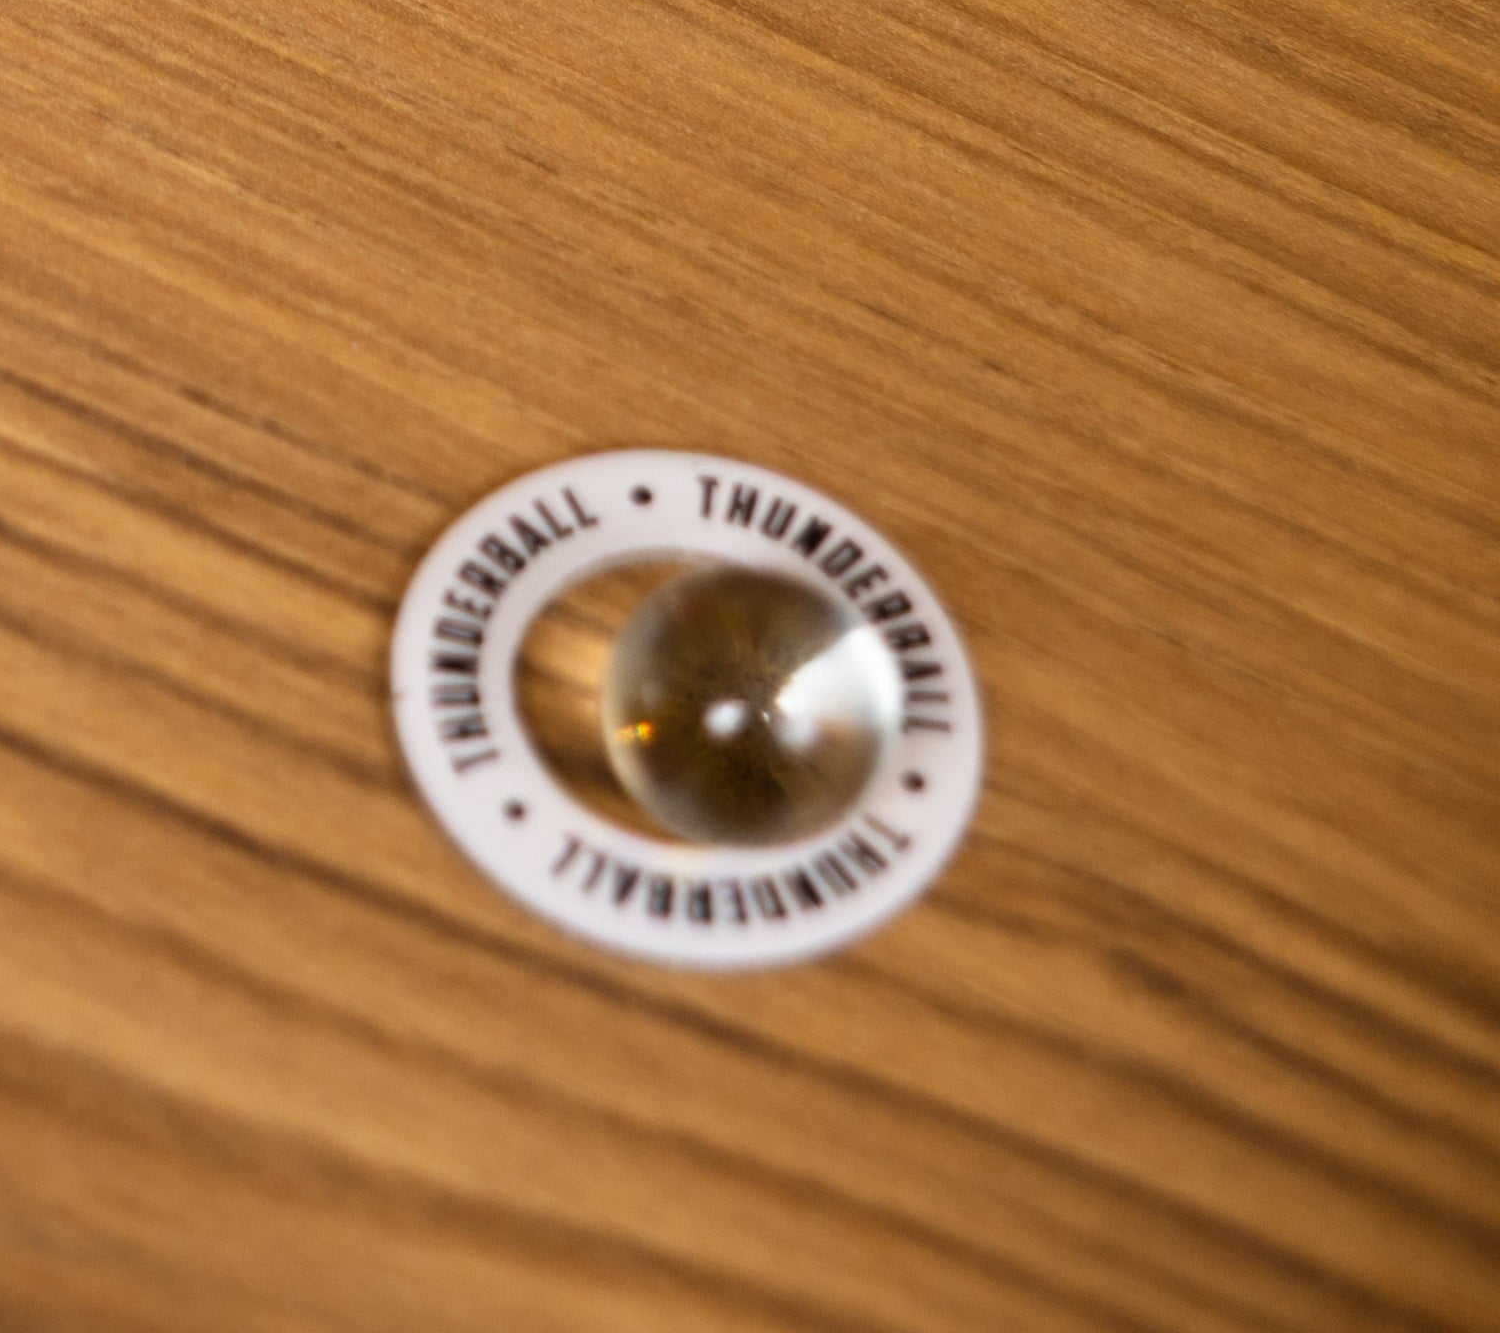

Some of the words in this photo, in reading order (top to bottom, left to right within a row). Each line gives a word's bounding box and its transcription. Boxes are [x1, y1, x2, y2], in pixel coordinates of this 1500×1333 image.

[429, 487, 599, 775] THUNDERBALL
[698, 473, 952, 738] THUNDERBALL
[548, 811, 910, 926] THUNDERBALL
